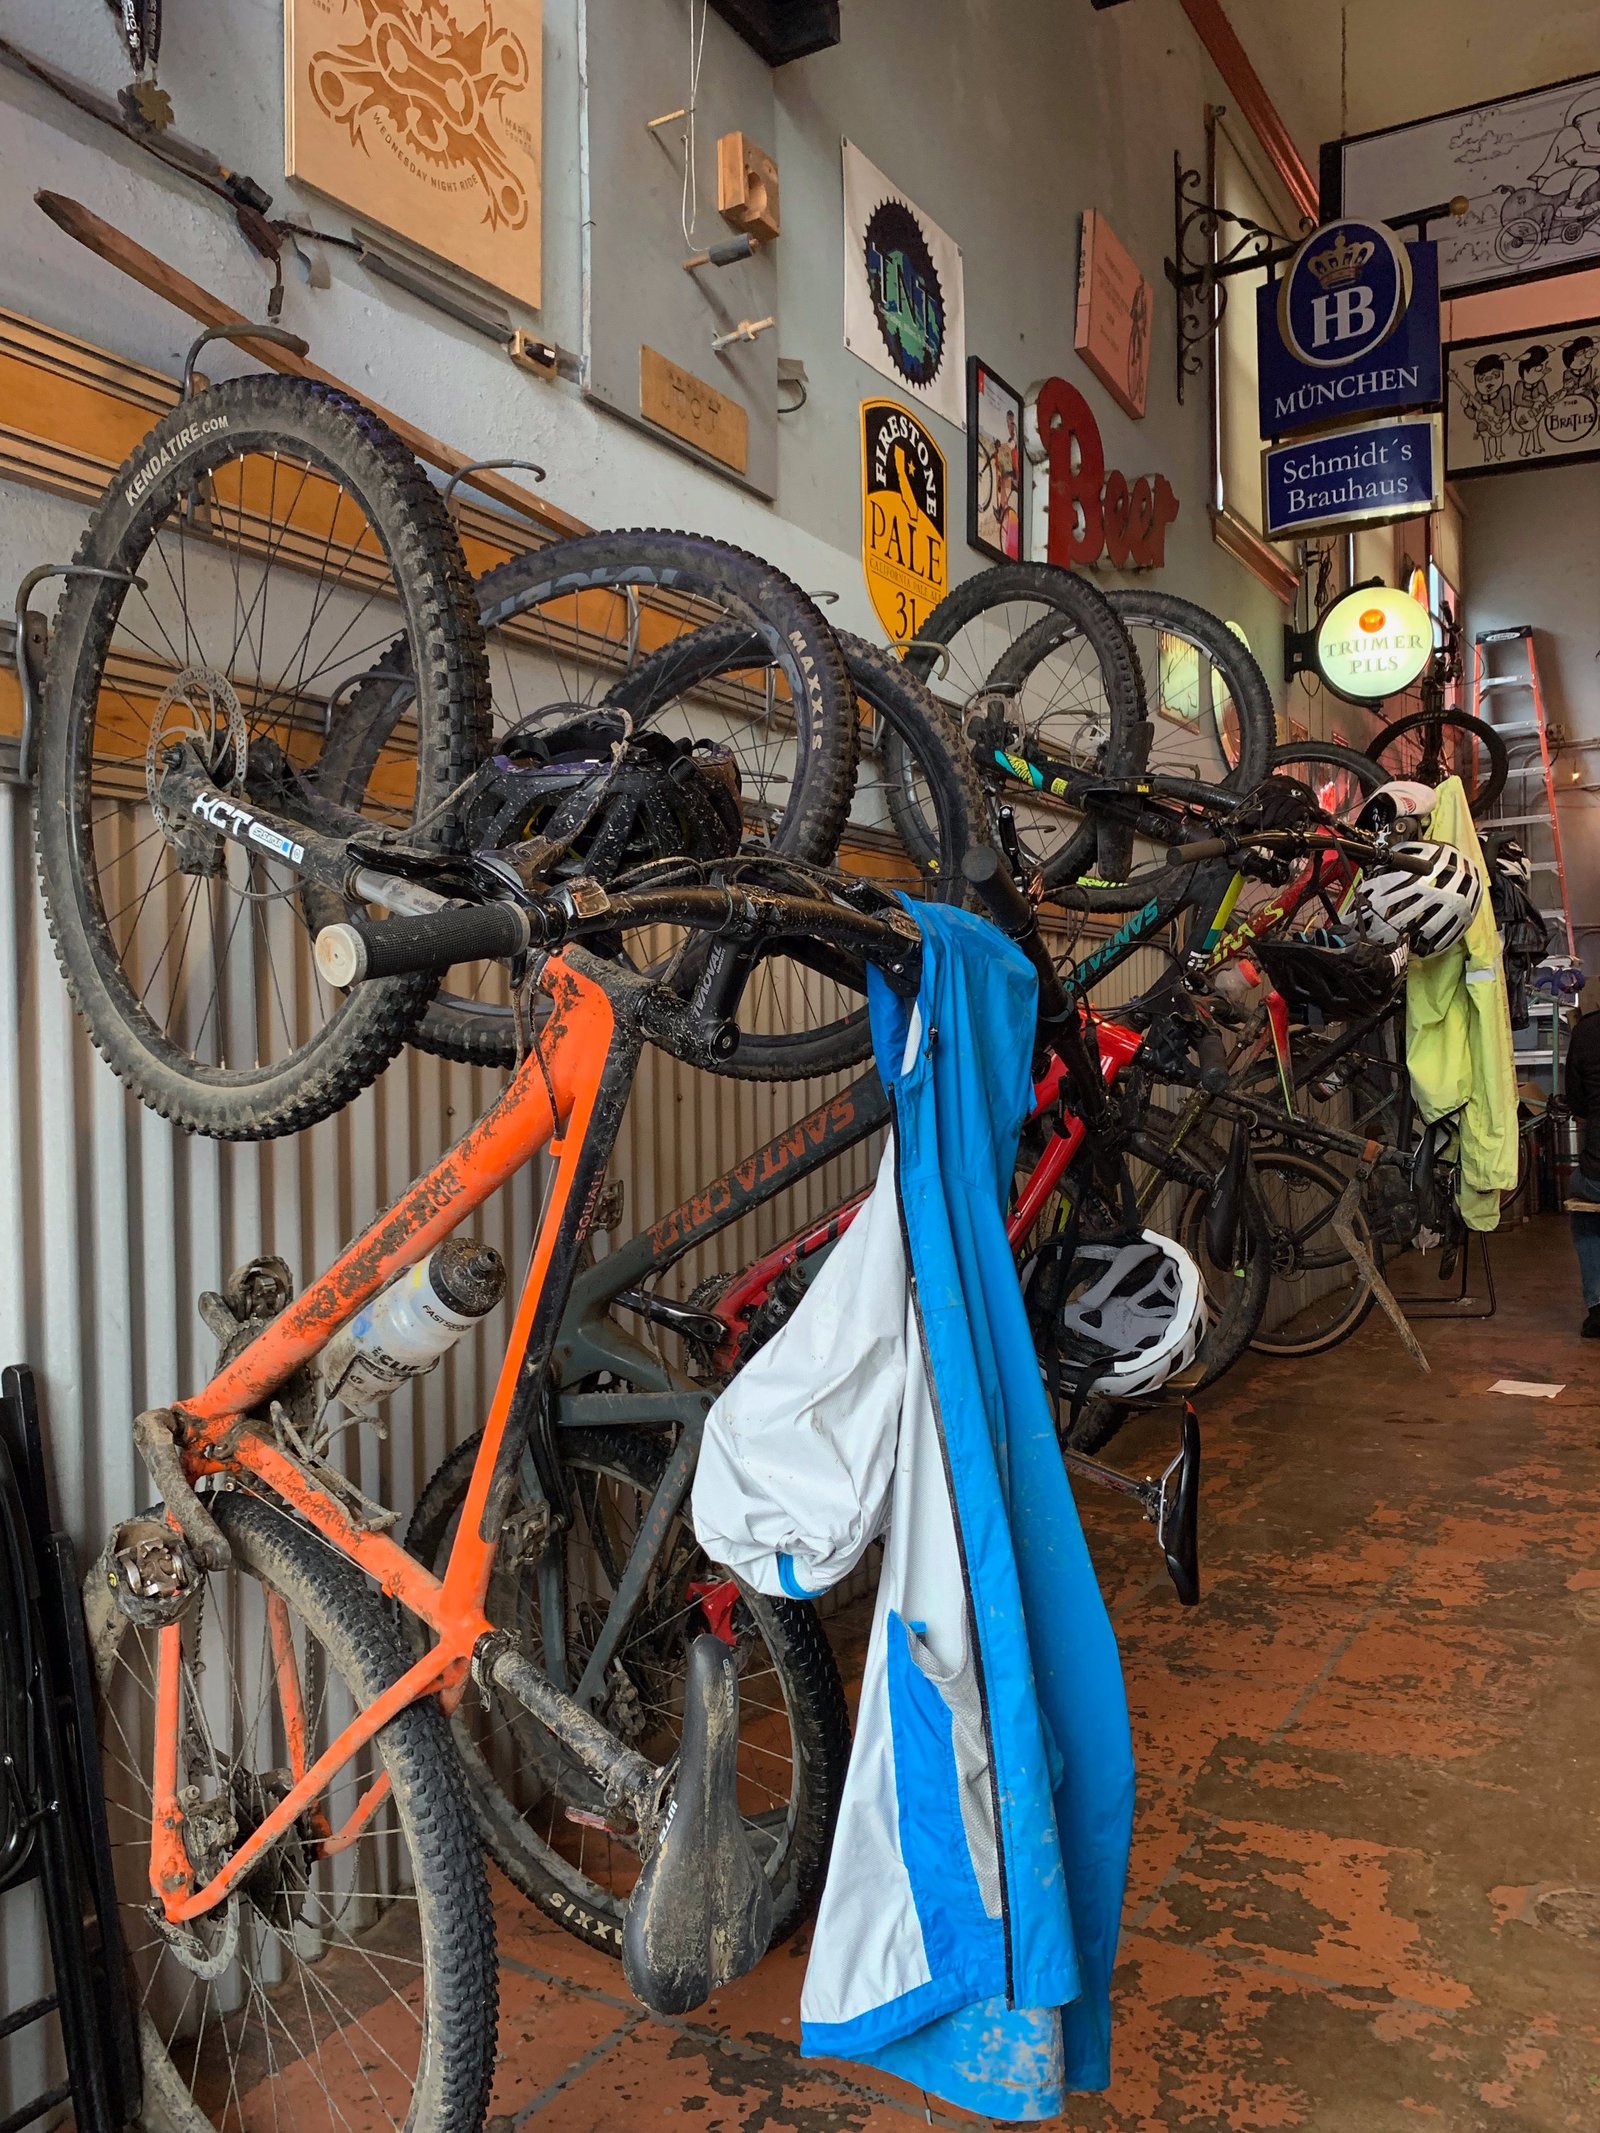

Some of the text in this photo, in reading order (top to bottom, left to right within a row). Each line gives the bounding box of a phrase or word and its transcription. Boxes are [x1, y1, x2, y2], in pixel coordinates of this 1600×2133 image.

[373, 112, 478, 192] WEDNESDAY NIGHT RIDE
[1311, 285, 1376, 348] HB
[1274, 366, 1419, 418] MÜNCHEN
[124, 415, 229, 507] KENDATIRE.COM
[875, 415, 937, 517] FIRESTONE
[1036, 376, 1180, 570] Beer
[1287, 476, 1409, 514] Brauhaus
[869, 557, 911, 588] CALIFORNIA
[870, 500, 943, 586] PALE
[895, 591, 917, 640] 31
[1324, 634, 1424, 658] TRUMER
[788, 630, 824, 751] MAXXIS
[1348, 655, 1399, 675] PILS
[734, 1091, 856, 1193] SANTA
[575, 1165, 606, 1241] SQUALL
[548, 1892, 623, 1946] AXXIS
